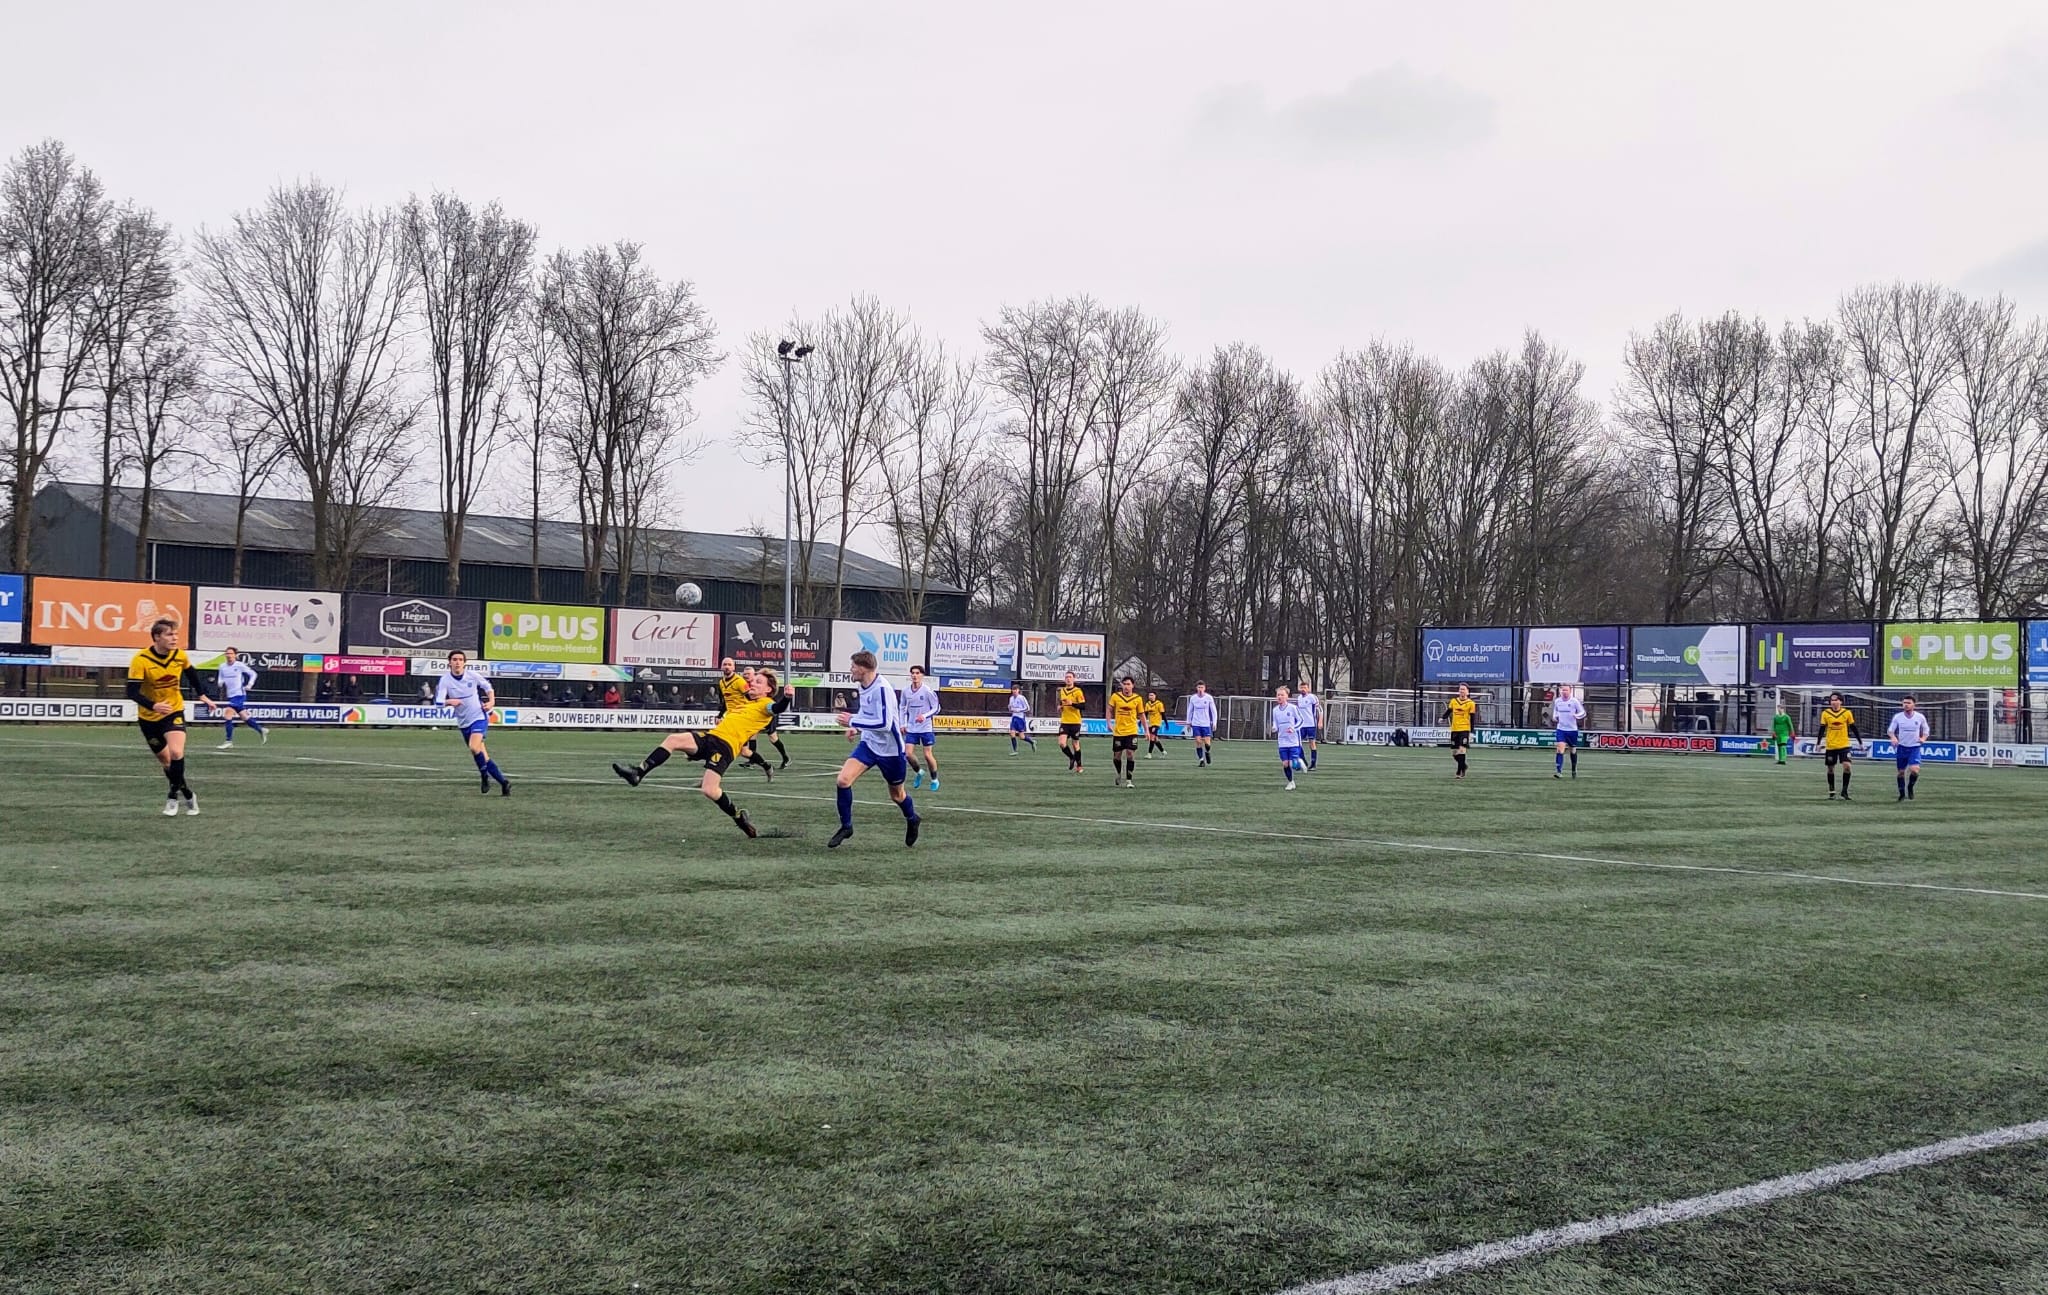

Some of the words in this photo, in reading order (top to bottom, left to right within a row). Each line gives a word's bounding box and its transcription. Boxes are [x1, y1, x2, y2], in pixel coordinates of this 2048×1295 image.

[204, 600, 236, 612] ZIET
[240, 602, 250, 612] U
[254, 603, 292, 614] GEEN
[38, 600, 125, 632] ING
[203, 614, 232, 625] BAL
[237, 615, 286, 627] MEER?
[401, 611, 430, 622] Hegen
[415, 627, 444, 635] Montage
[518, 614, 598, 641] PLUS
[631, 615, 701, 641] Gert
[883, 632, 908, 650] VVS
[935, 631, 995, 643] AUTOBEDRIJF
[491, 641, 510, 650] Van
[512, 642, 529, 651] den
[533, 643, 597, 653] Hoven-Heerde
[935, 642, 952, 650] VAN
[954, 643, 995, 652] HUFFELEN
[1026, 640, 1100, 656] BROUWER
[1447, 644, 1471, 653] Arslan
[1472, 644, 1480, 652] &
[1480, 644, 1513, 654] partner
[1919, 634, 2013, 661] PLUS
[883, 651, 908, 662] BOUW
[1446, 653, 1488, 662] advocaten
[1542, 652, 1560, 662] nu
[1688, 649, 1697, 660] K
[238, 653, 256, 666] De
[258, 653, 298, 669] Spikke
[1890, 665, 1910, 675] Van
[1913, 665, 1932, 675] den
[1935, 665, 2013, 675] Hoven-Heerde
[291, 709, 309, 719] TER
[310, 709, 339, 719] VELDE
[548, 712, 614, 724] BOUWBEDRIJF
[617, 714, 638, 725] NHM
[640, 714, 685, 725] IJZERMAN
[687, 715, 701, 725] B.V.
[1600, 735, 1625, 747] PRO
[1627, 736, 1688, 749] CARWASH
[1690, 738, 1715, 751] EPE
[1722, 740, 1759, 749] Heineken
